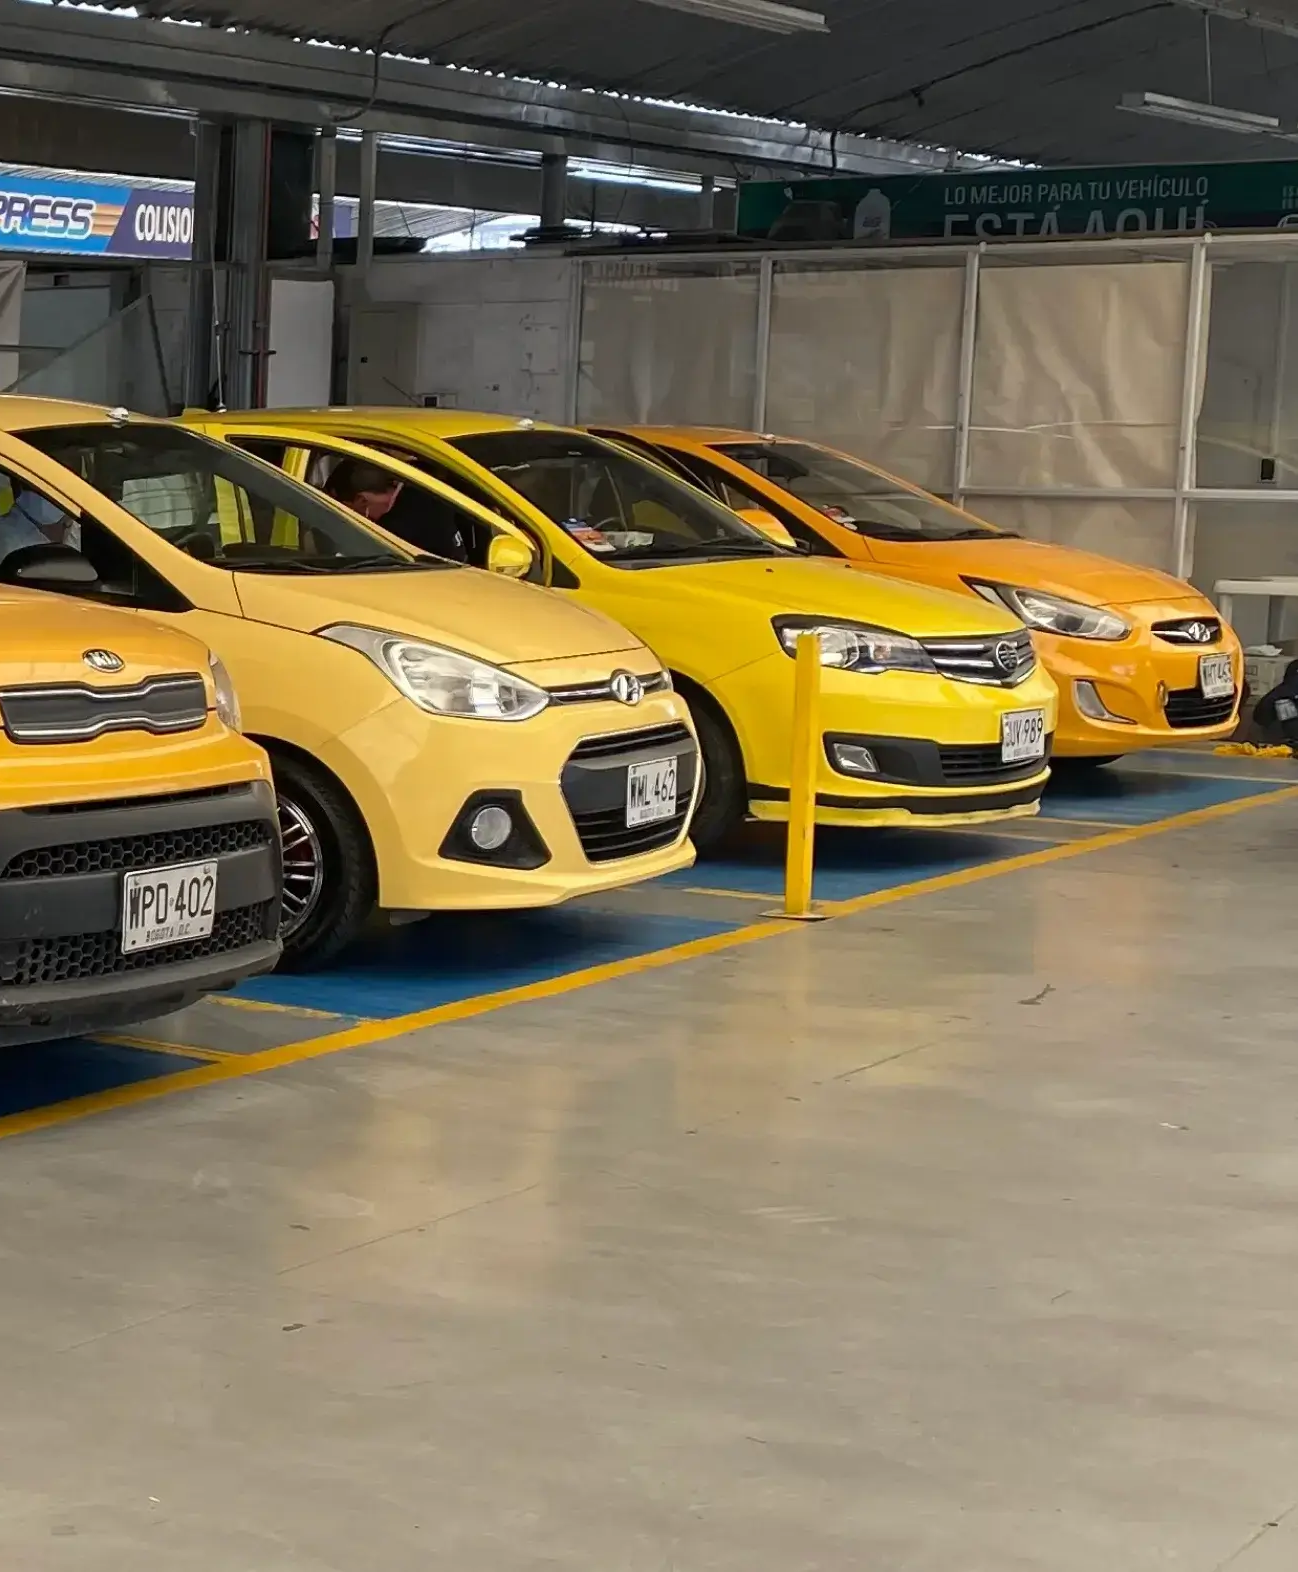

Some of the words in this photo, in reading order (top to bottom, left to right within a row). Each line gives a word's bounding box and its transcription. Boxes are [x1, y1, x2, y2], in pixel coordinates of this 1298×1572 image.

[944, 186, 966, 206] LO
[970, 184, 1033, 205] MEJOR
[1037, 182, 1084, 203] PARA
[1088, 180, 1111, 201] TU
[1115, 174, 1209, 200] VEHÍCULO
[134, 202, 195, 244] COLISIO
